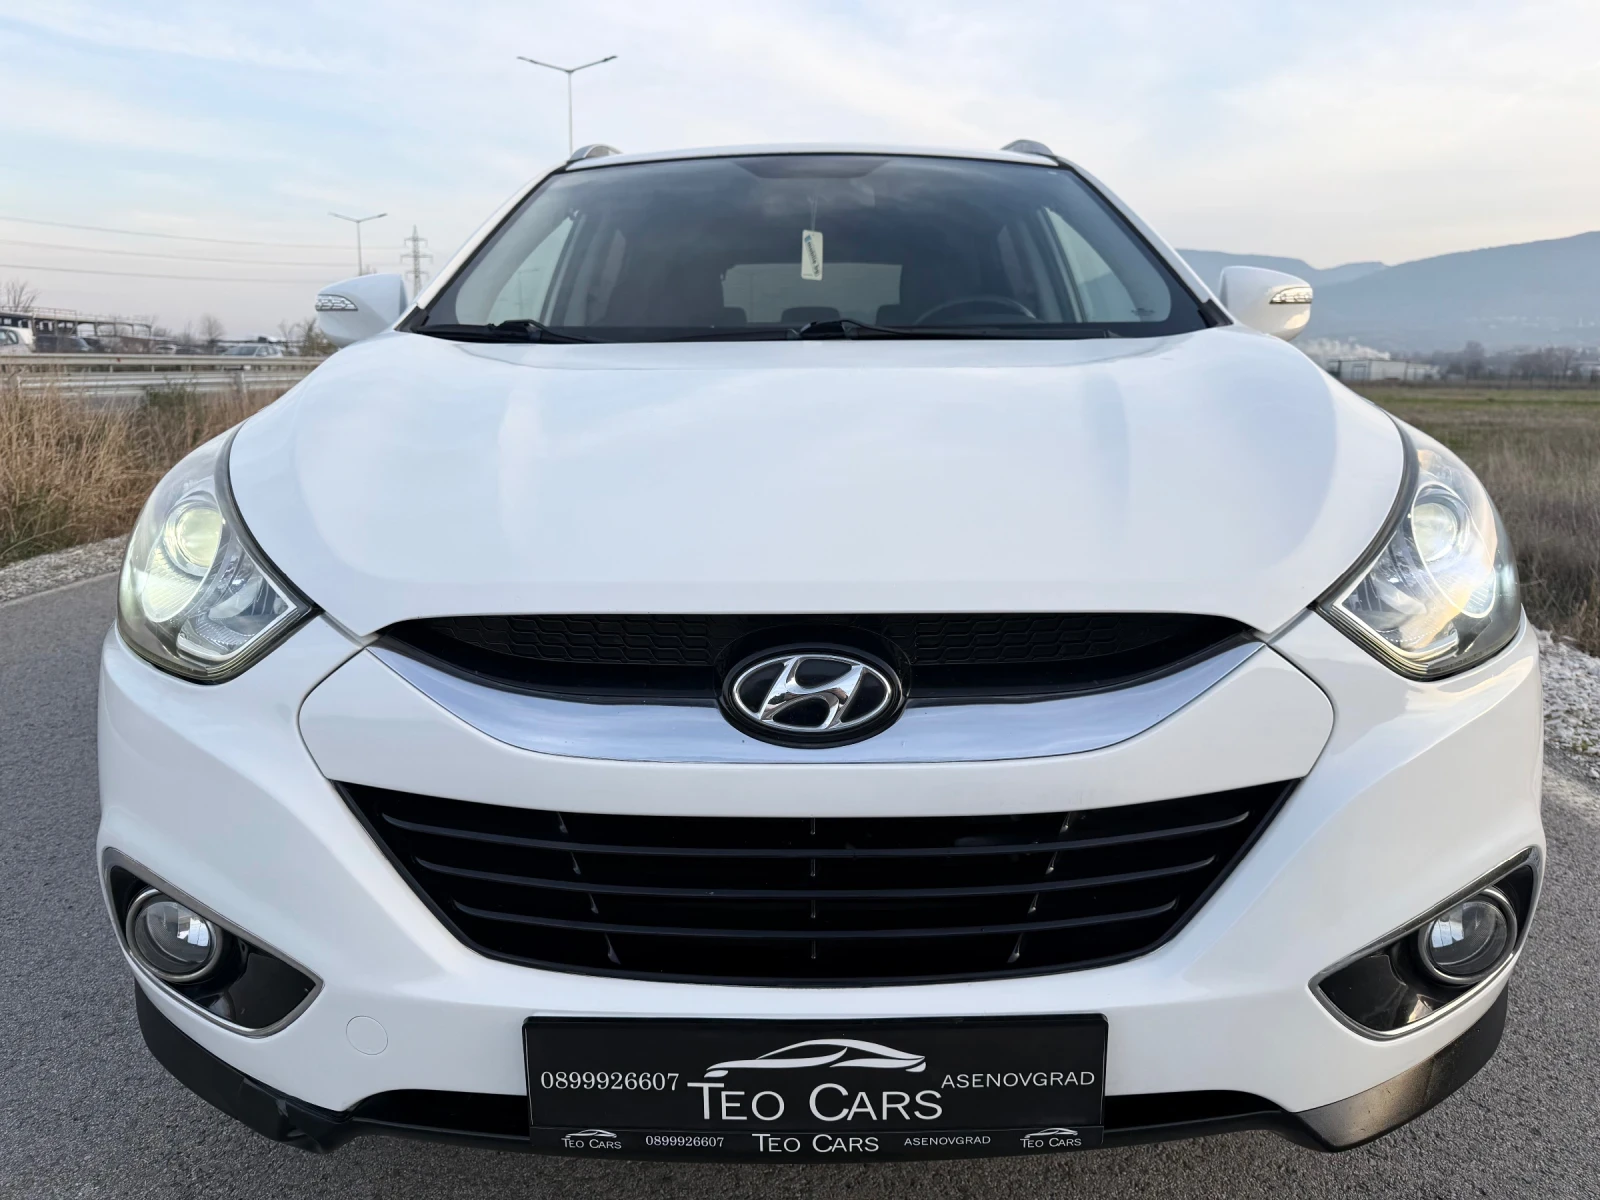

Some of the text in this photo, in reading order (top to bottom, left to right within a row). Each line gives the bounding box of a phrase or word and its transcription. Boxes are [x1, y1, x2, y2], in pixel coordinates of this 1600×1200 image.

[540, 1071, 680, 1091] 0899926607
[941, 1071, 1095, 1089] ASENOVGRAD
[645, 1135, 724, 1148] 0899926607
[903, 1135, 991, 1147] ASENOVGRAD
